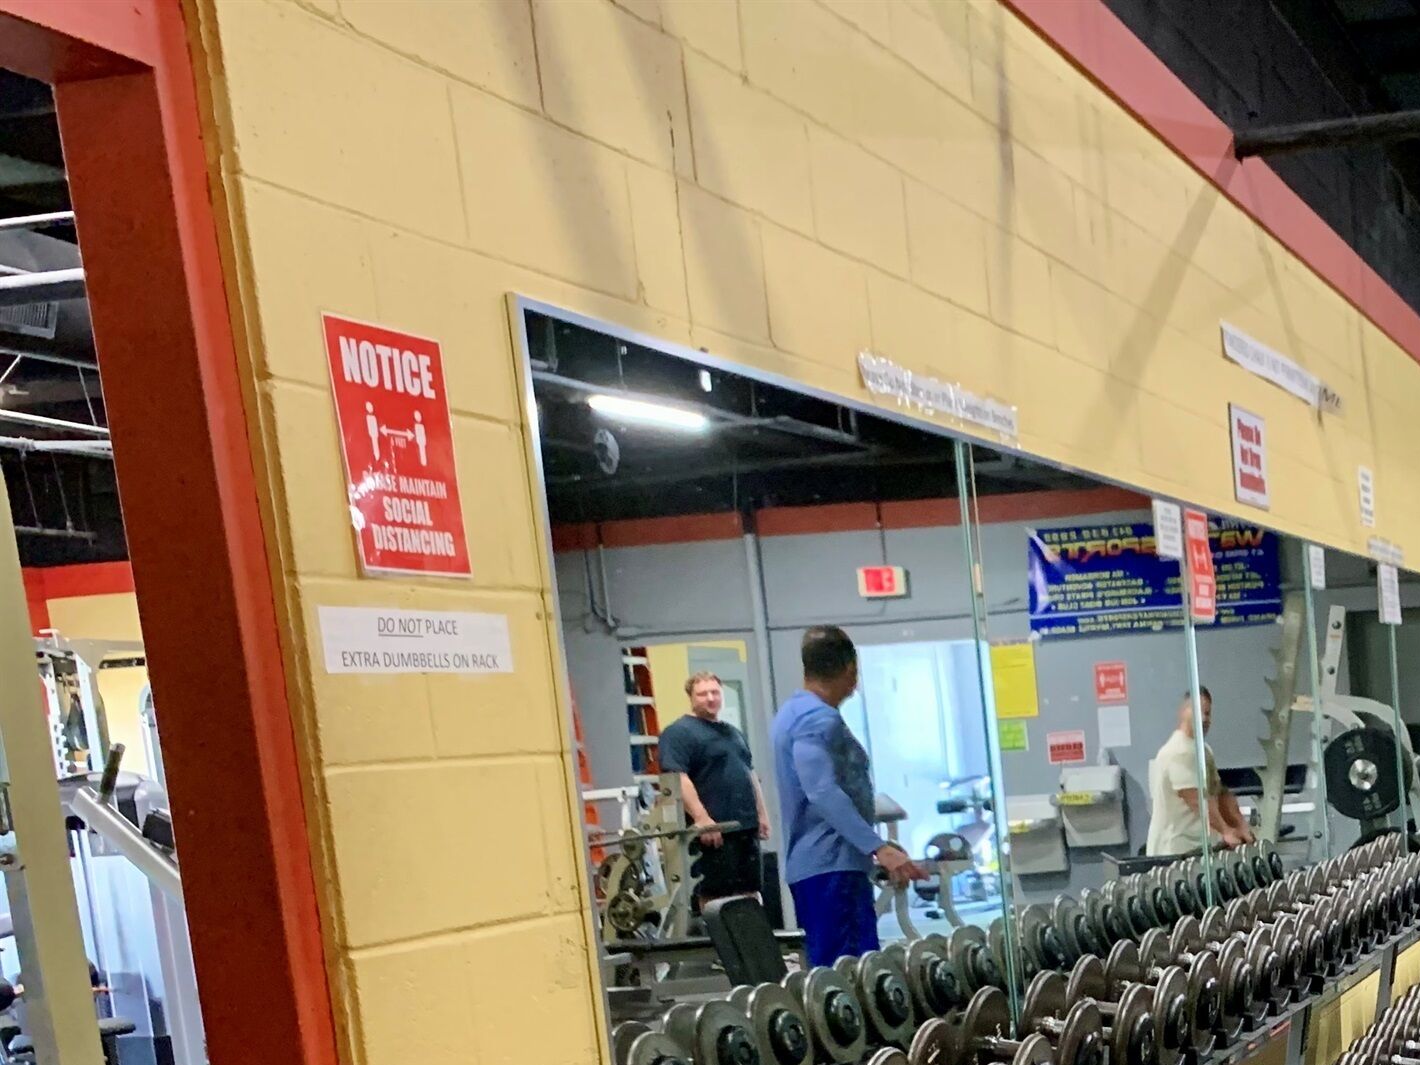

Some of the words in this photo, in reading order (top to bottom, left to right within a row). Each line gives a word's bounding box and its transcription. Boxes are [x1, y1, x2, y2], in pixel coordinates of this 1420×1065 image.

[339, 335, 436, 399] NOTICE
[400, 474, 447, 499] MAINTAIN
[383, 496, 433, 527] SOCIAL
[371, 524, 456, 557] DISTANCING
[377, 617, 395, 633] DO
[399, 618, 423, 634] NOT
[425, 619, 458, 635] PLACE
[341, 651, 380, 667] EXTRA
[384, 652, 450, 668] DUMBBELLS
[453, 654, 469, 668] ON
[472, 654, 500, 669] RACK
